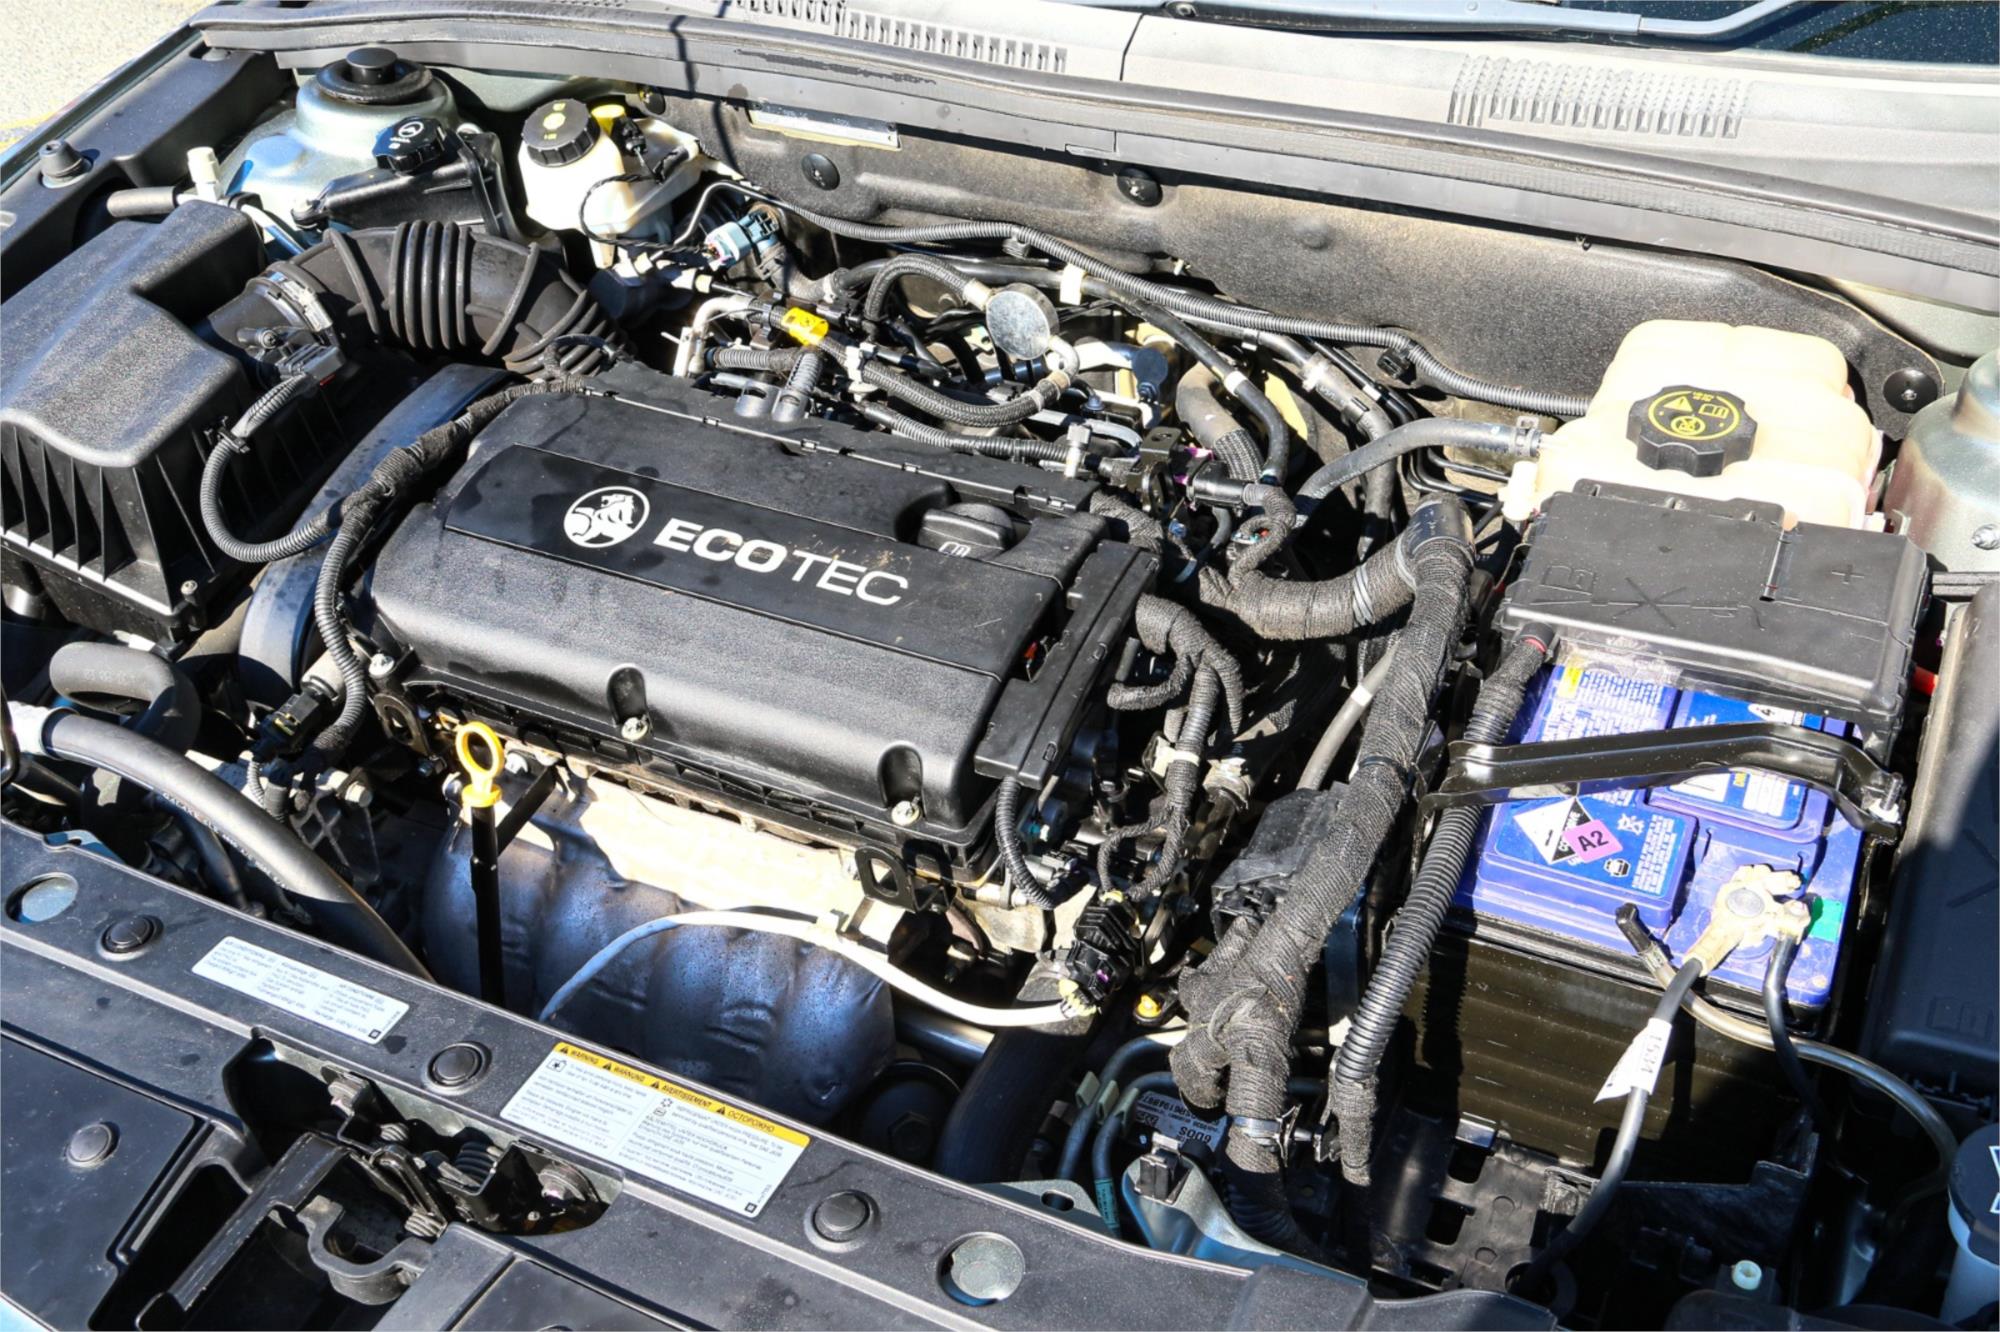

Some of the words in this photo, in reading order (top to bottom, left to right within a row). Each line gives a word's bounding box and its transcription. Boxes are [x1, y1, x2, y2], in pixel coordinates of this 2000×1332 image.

[653, 518, 909, 606] ECOTEC
[1578, 830, 1609, 852] A2
[571, 1050, 598, 1065] WARNING
